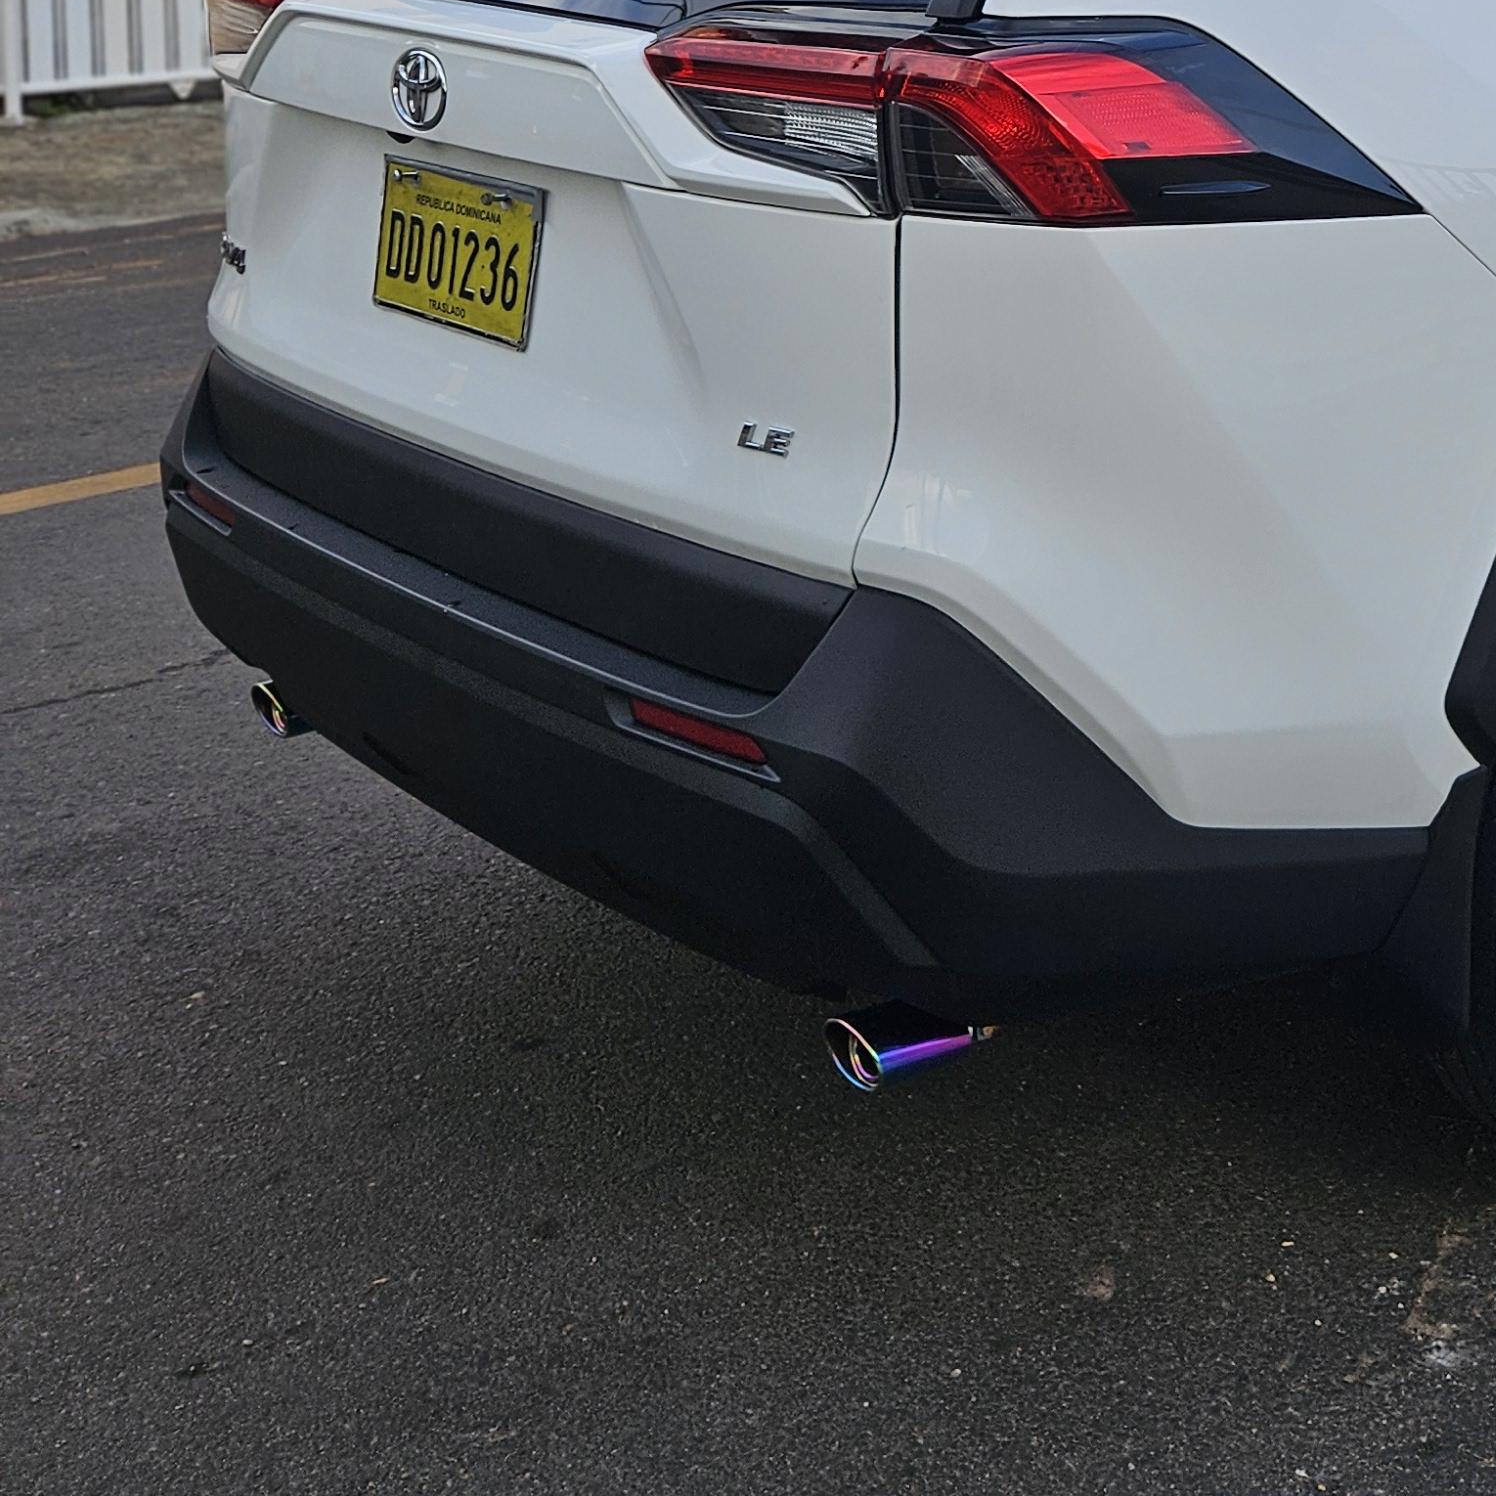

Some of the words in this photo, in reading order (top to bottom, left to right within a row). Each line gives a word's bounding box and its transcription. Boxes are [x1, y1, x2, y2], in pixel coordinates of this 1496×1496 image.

[456, 203, 502, 224] DOMINICANA
[385, 210, 519, 311] DD01236
[428, 298, 465, 318] TRASLADO
[737, 421, 795, 458] LE
